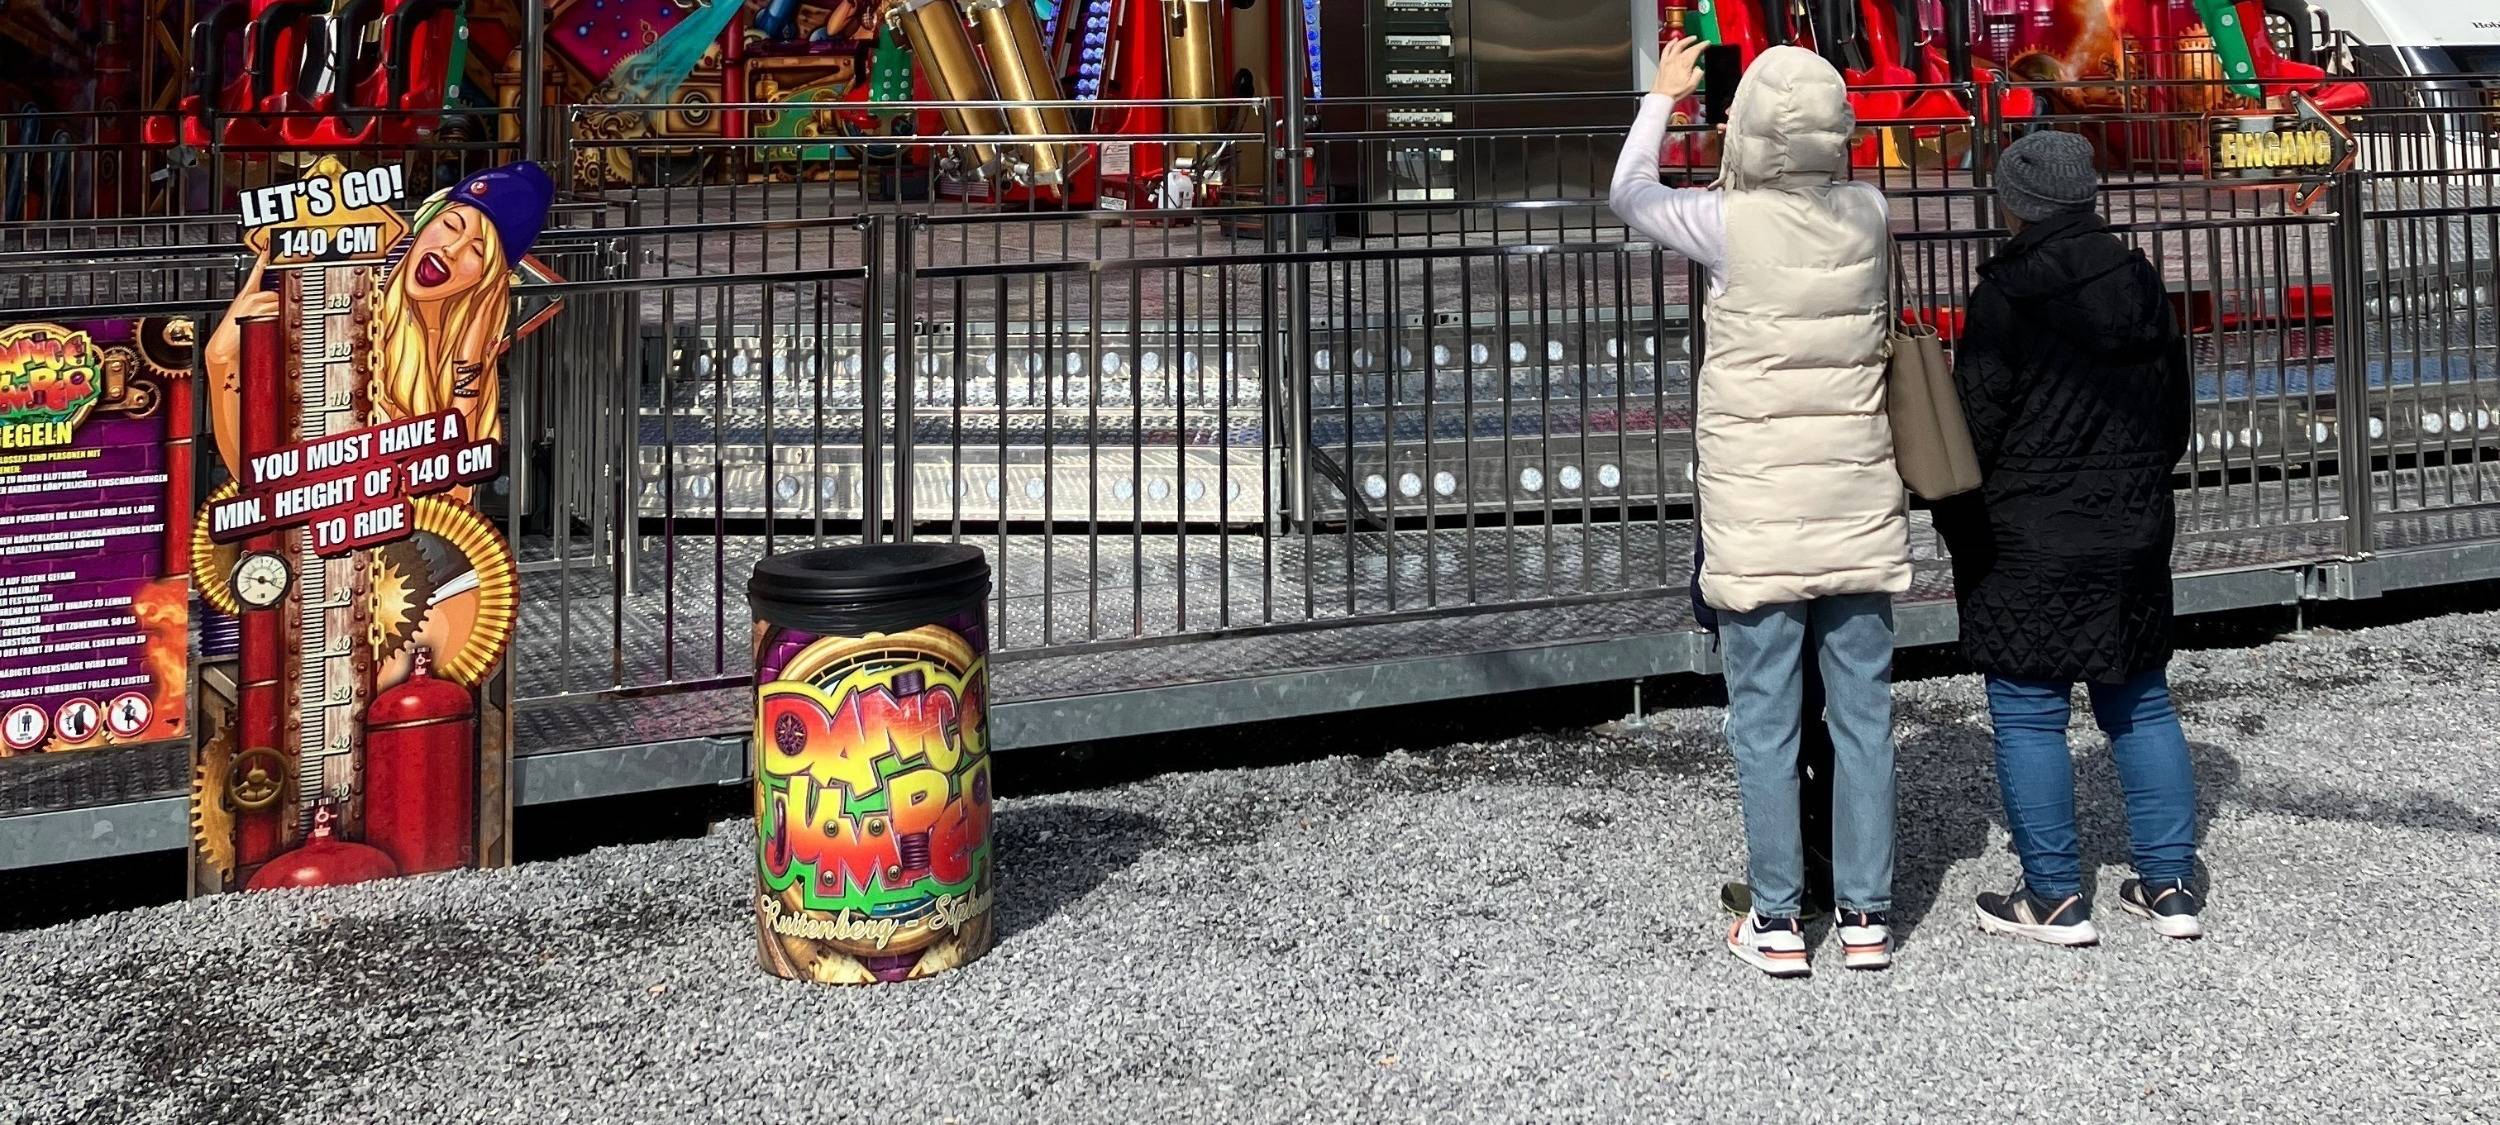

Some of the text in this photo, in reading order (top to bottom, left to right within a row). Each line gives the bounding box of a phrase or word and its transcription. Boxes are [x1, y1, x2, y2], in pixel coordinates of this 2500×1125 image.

[2221, 130, 2331, 168] EINGANG
[240, 165, 404, 227] LET'S GO!
[279, 225, 377, 257] 140 CM
[328, 294, 351, 308] 130
[329, 343, 352, 357] 120
[330, 392, 351, 407] 110
[0, 421, 73, 449] EGELN
[251, 413, 458, 484] YOU MUST HAVE A
[214, 444, 493, 533] MIN. HEIGHT OF 140 CM
[316, 503, 404, 546] TO RIDE
[333, 588, 351, 602] 70
[333, 636, 351, 651] 60
[333, 687, 351, 700] 50
[331, 735, 350, 750] 40
[764, 667, 986, 796] DANCE
[331, 783, 350, 798] 30
[761, 894, 897, 950] Ruitenberg
